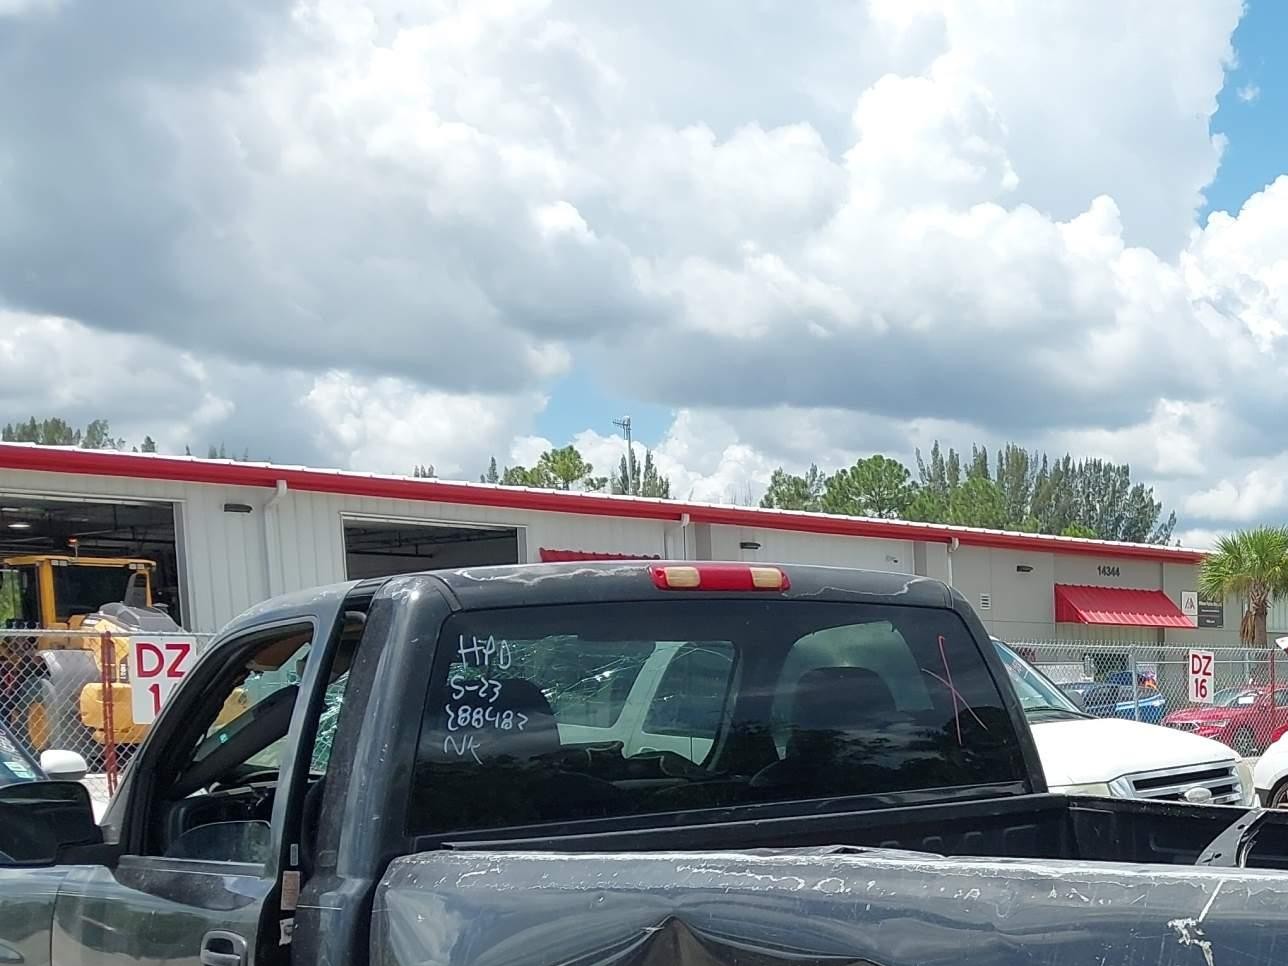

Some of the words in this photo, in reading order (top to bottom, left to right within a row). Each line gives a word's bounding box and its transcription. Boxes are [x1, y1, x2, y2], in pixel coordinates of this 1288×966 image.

[1097, 565, 1120, 577] 14344
[135, 643, 191, 678] DZ
[1191, 654, 1212, 676] DZ
[1194, 678, 1207, 698] 16
[148, 683, 162, 718] 1
